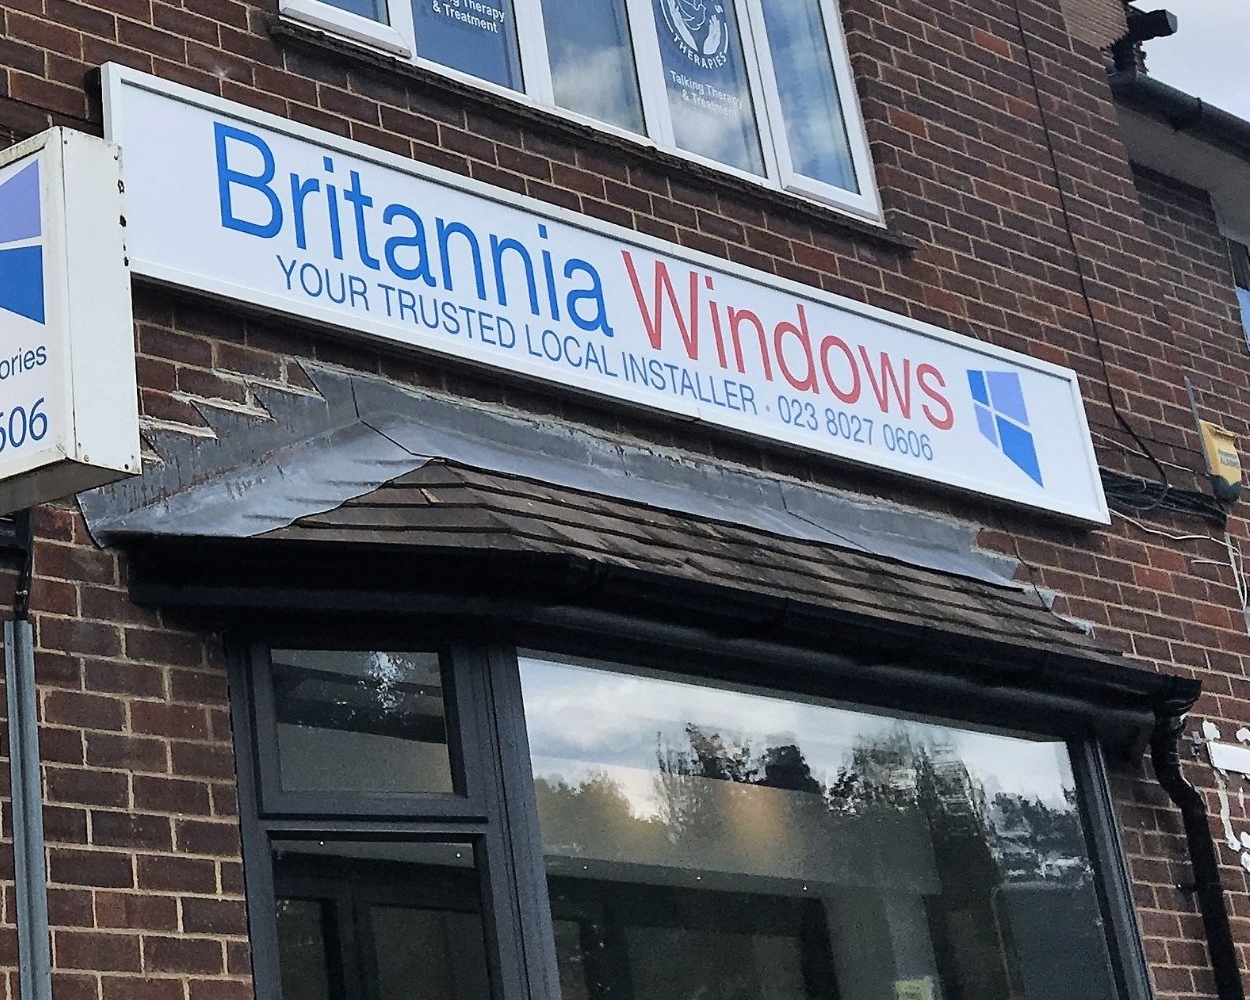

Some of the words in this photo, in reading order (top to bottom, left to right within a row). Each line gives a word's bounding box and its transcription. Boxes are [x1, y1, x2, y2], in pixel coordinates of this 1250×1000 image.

[432, 0, 442, 14] &
[443, 3, 498, 34] Treatment
[673, 32, 727, 70] THERAPIES
[670, 69, 705, 96] Talking
[213, 121, 614, 338] Britannia
[620, 249, 954, 431] Windows
[276, 254, 369, 306] YOUR
[377, 283, 516, 350] TRUSTED
[524, 323, 618, 378] LOCAL
[621, 351, 758, 416] INSTALLER
[777, 394, 820, 432] 023
[826, 407, 875, 446] 8027
[883, 423, 934, 461] 0606
